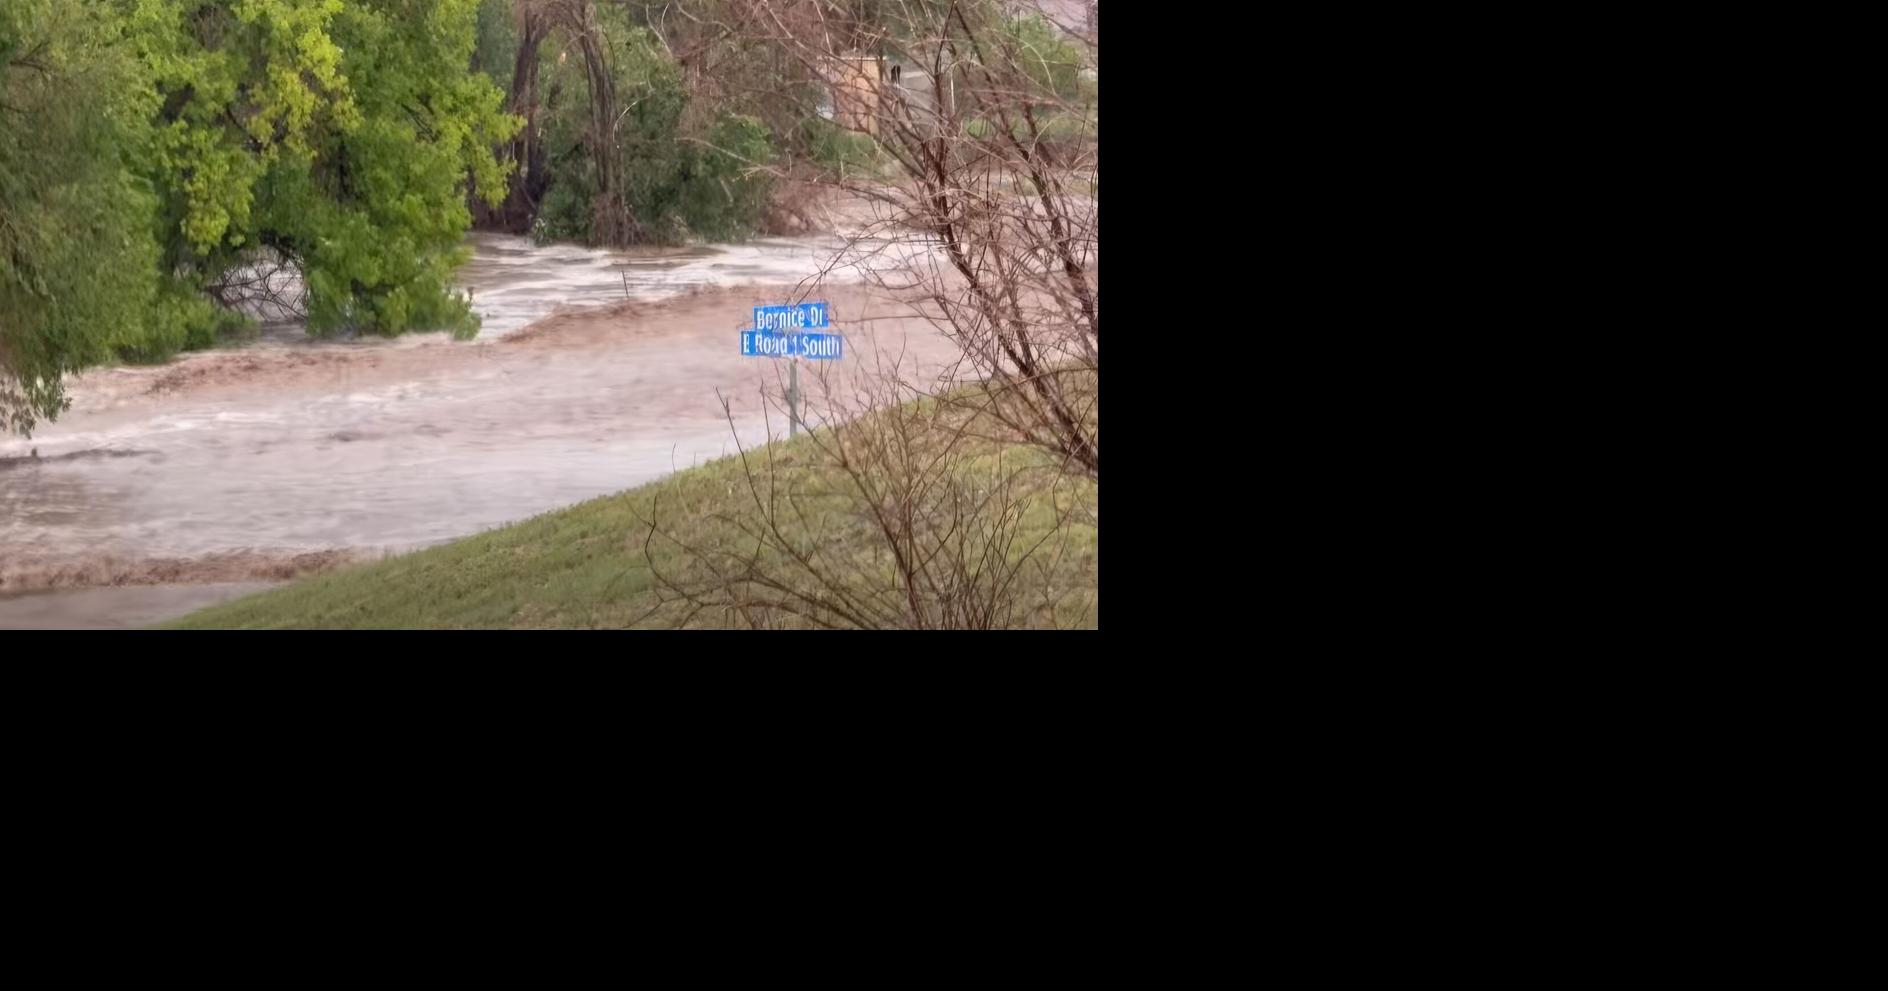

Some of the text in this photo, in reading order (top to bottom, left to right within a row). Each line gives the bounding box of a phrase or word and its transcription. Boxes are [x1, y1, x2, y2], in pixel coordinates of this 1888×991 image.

[743, 333, 750, 353] E
[755, 334, 788, 354] Road
[802, 335, 840, 356] South
